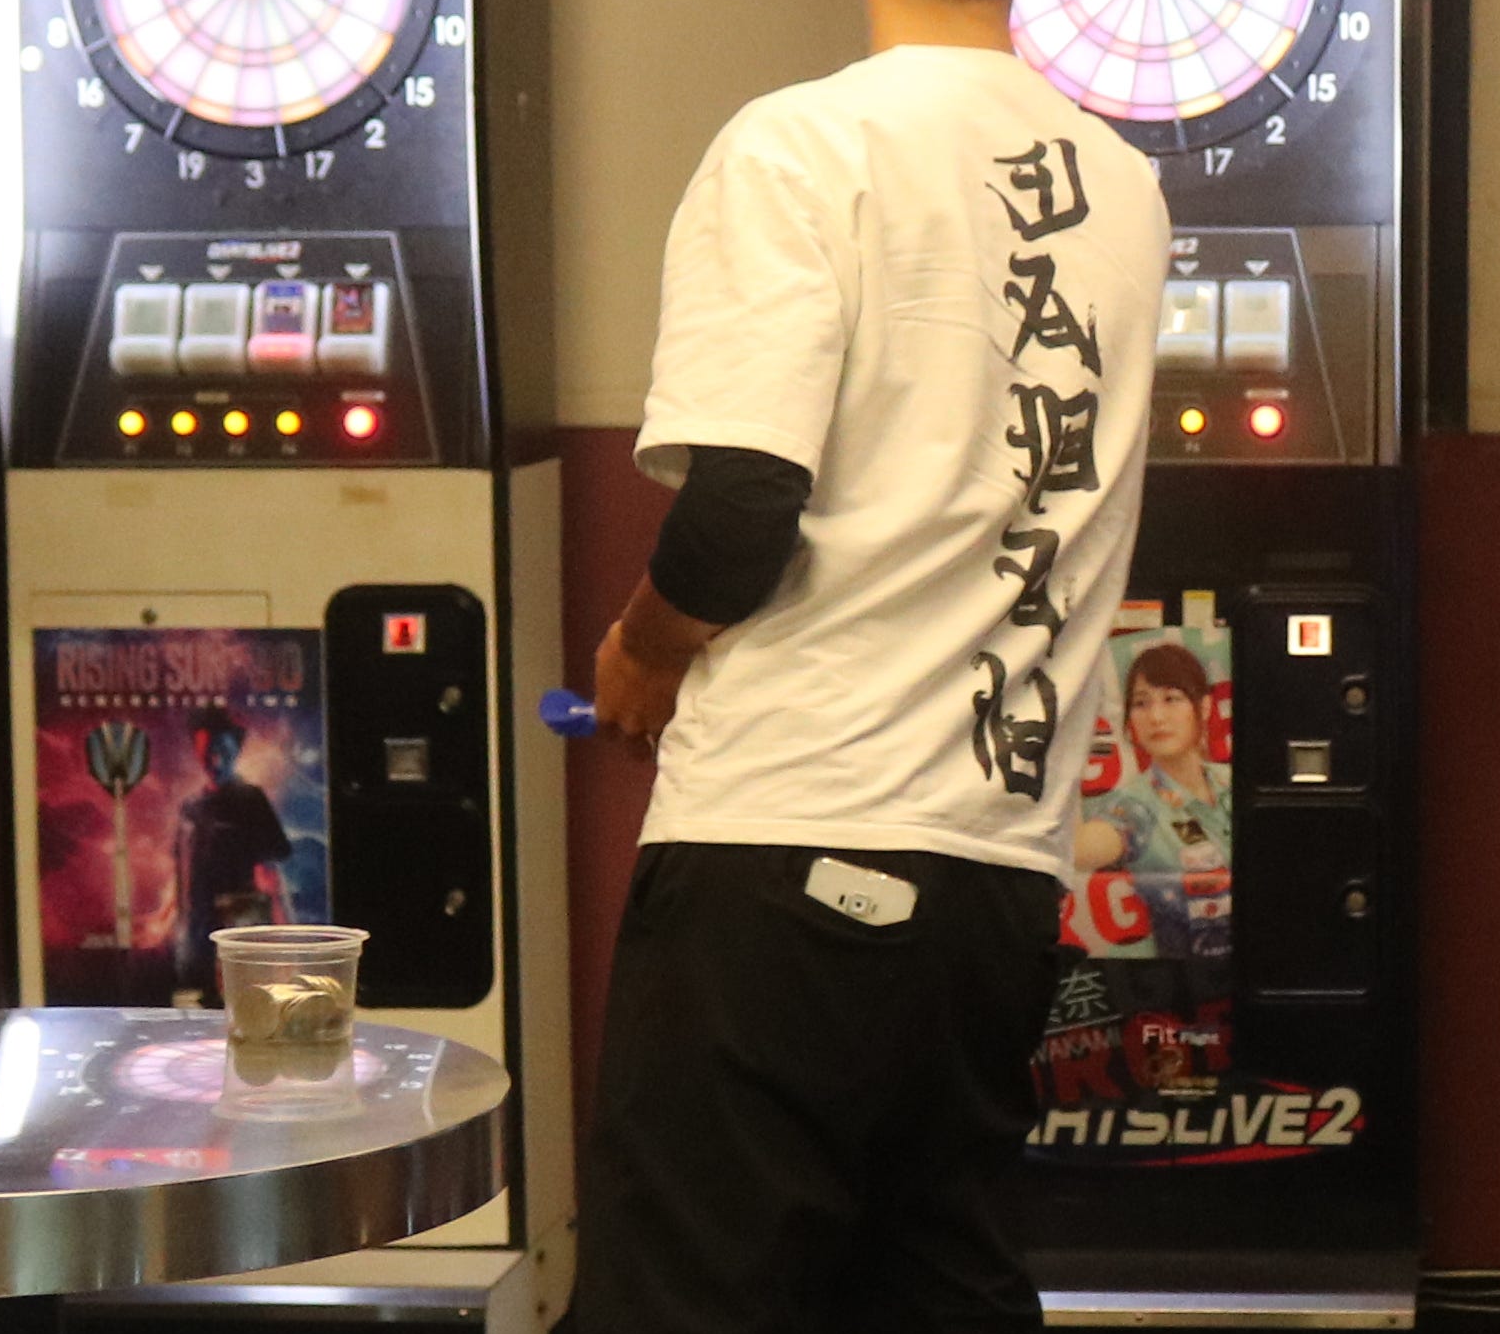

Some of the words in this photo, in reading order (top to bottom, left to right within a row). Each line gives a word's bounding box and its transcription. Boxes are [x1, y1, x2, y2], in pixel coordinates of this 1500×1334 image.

[49, 19, 67, 46] 8
[438, 18, 466, 44] 10
[1341, 12, 1369, 40] 10
[78, 79, 103, 106] 16
[407, 78, 433, 105] 15
[1310, 74, 1336, 101] 15
[125, 124, 143, 151] 7
[366, 120, 384, 147] 2
[1267, 116, 1285, 143] 2
[179, 153, 204, 177] 19
[306, 151, 334, 178] 17
[1205, 148, 1233, 174] 17
[247, 162, 264, 188] 3
[57, 643, 159, 691] RISING
[164, 643, 230, 691] SUN
[1142, 1024, 1179, 1045] Fit
